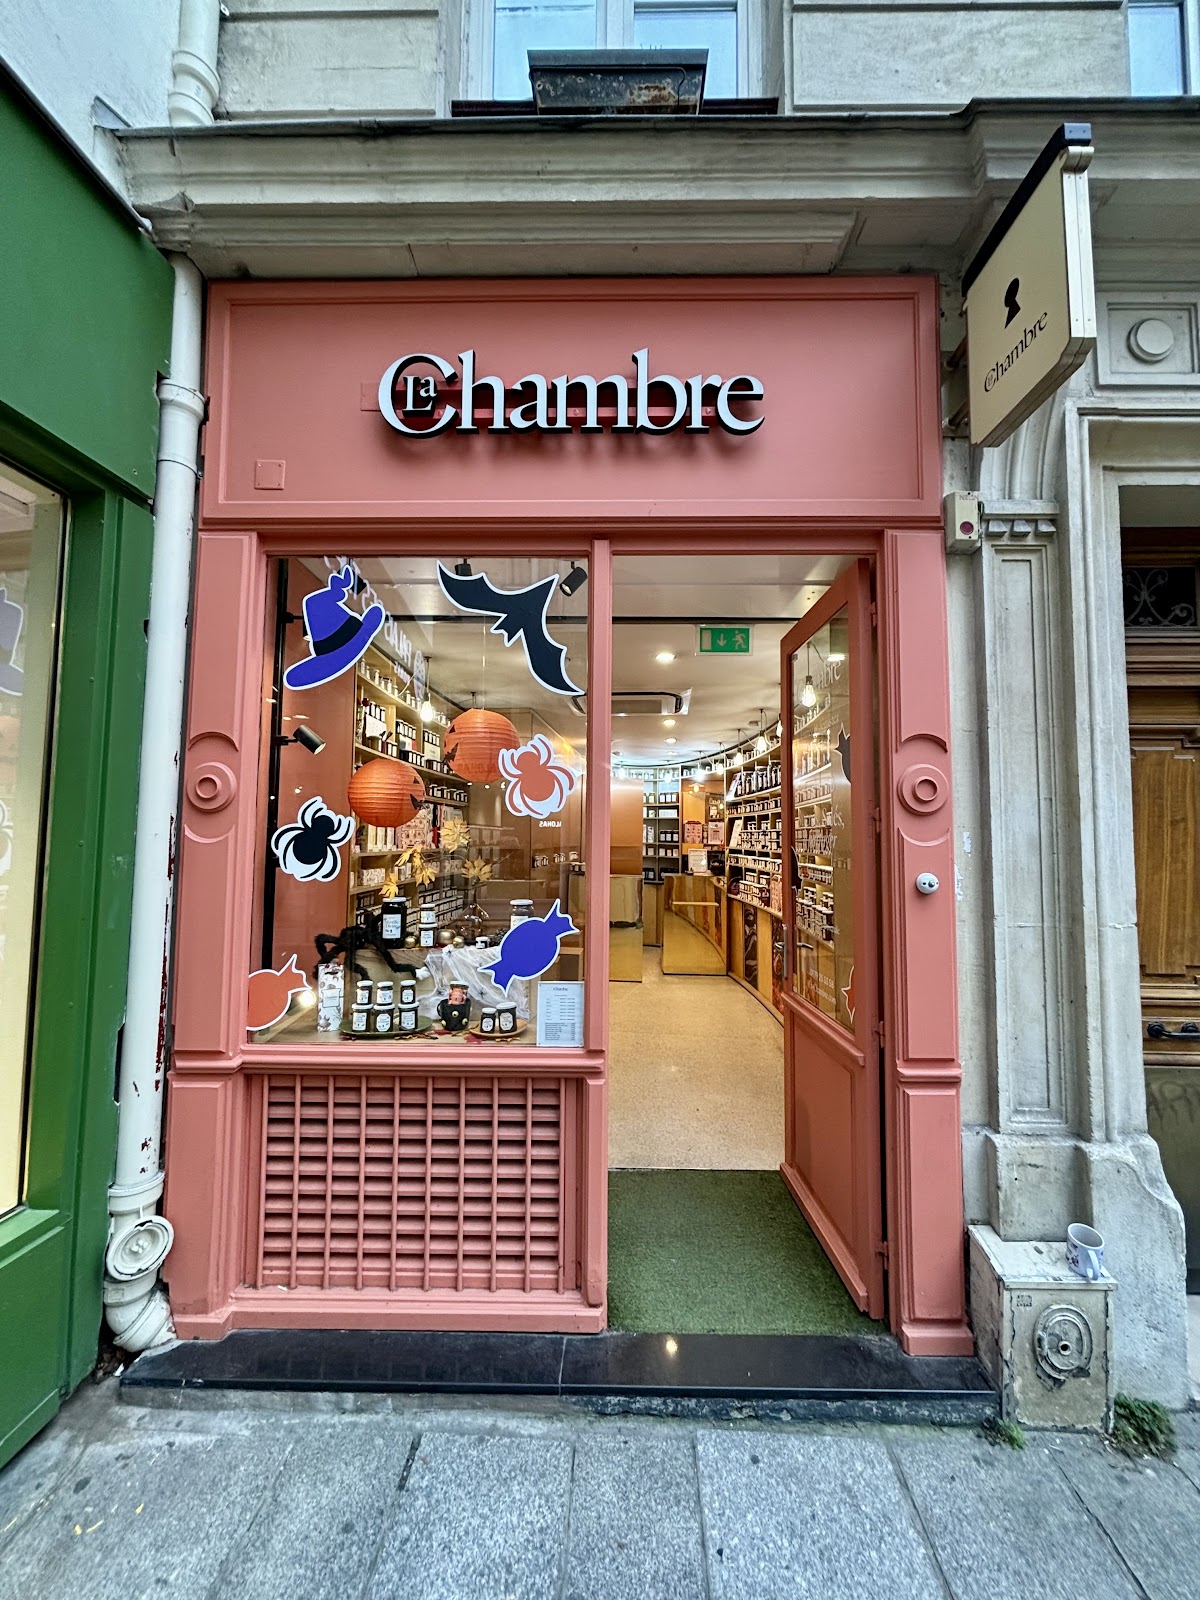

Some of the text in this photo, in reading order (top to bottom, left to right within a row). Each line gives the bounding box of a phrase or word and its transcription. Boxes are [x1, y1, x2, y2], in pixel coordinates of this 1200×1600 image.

[377, 348, 766, 436] La Chambre
[984, 311, 1048, 393] Chambre
